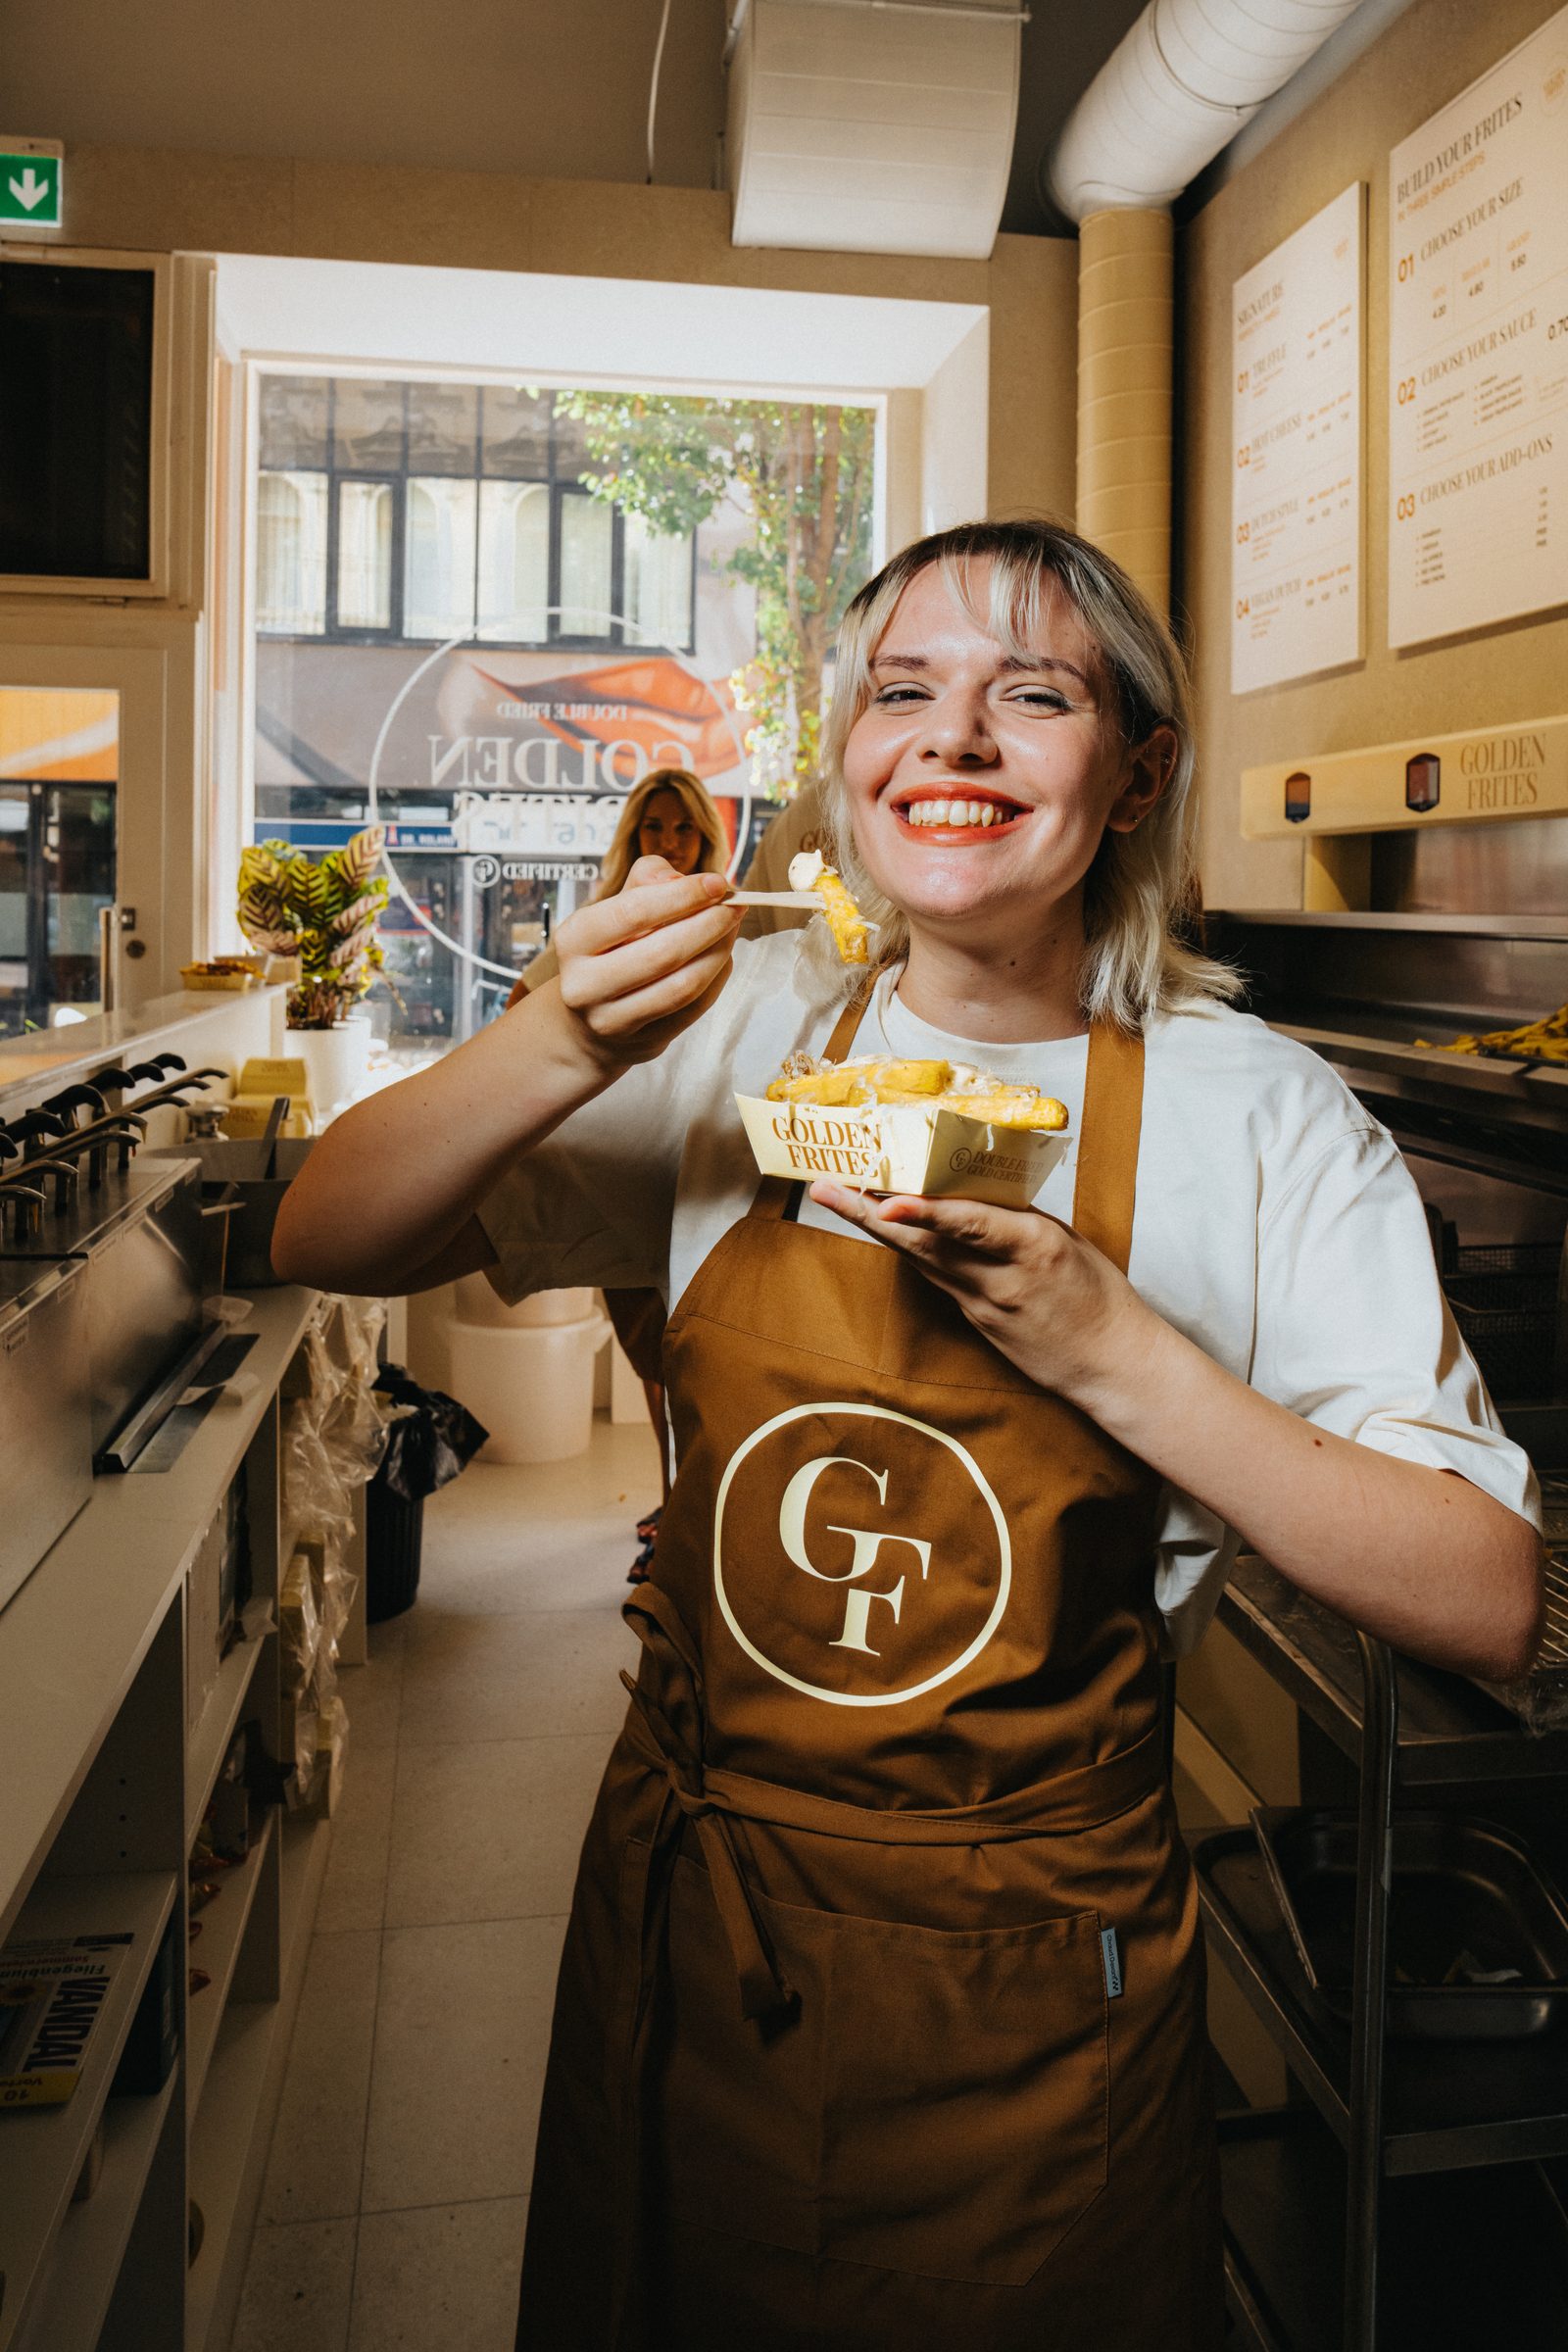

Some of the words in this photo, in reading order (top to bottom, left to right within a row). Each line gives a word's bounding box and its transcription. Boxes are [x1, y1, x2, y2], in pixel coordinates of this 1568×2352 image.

[1397, 161, 1435, 204] BUILD
[1436, 132, 1472, 172] YOUR
[1474, 95, 1522, 146] FRITES
[1398, 254, 1414, 282] 01
[1421, 218, 1464, 261] CHOOSE
[1466, 196, 1497, 231] YOUR
[1498, 176, 1524, 209] SIZE
[1397, 376, 1416, 406] 02
[1421, 350, 1464, 386] CHOOSE
[1467, 330, 1497, 362] YOUR
[1499, 307, 1537, 343] SAUCE
[1397, 493, 1415, 520] 03
[1421, 470, 1463, 505] CHOOSE
[1465, 459, 1495, 486] YOUR
[1499, 433, 1553, 472] ADD-ONS
[1460, 734, 1546, 776] GOLDEN
[1468, 771, 1538, 809] FRITES
[772, 1116, 882, 1152] GOLDEN
[785, 1144, 879, 1178] FRITES
[966, 1164, 994, 1177] GOLD
[973, 1151, 1017, 1170] DOUBLE
[22, 1976, 111, 2073] VANDAL
